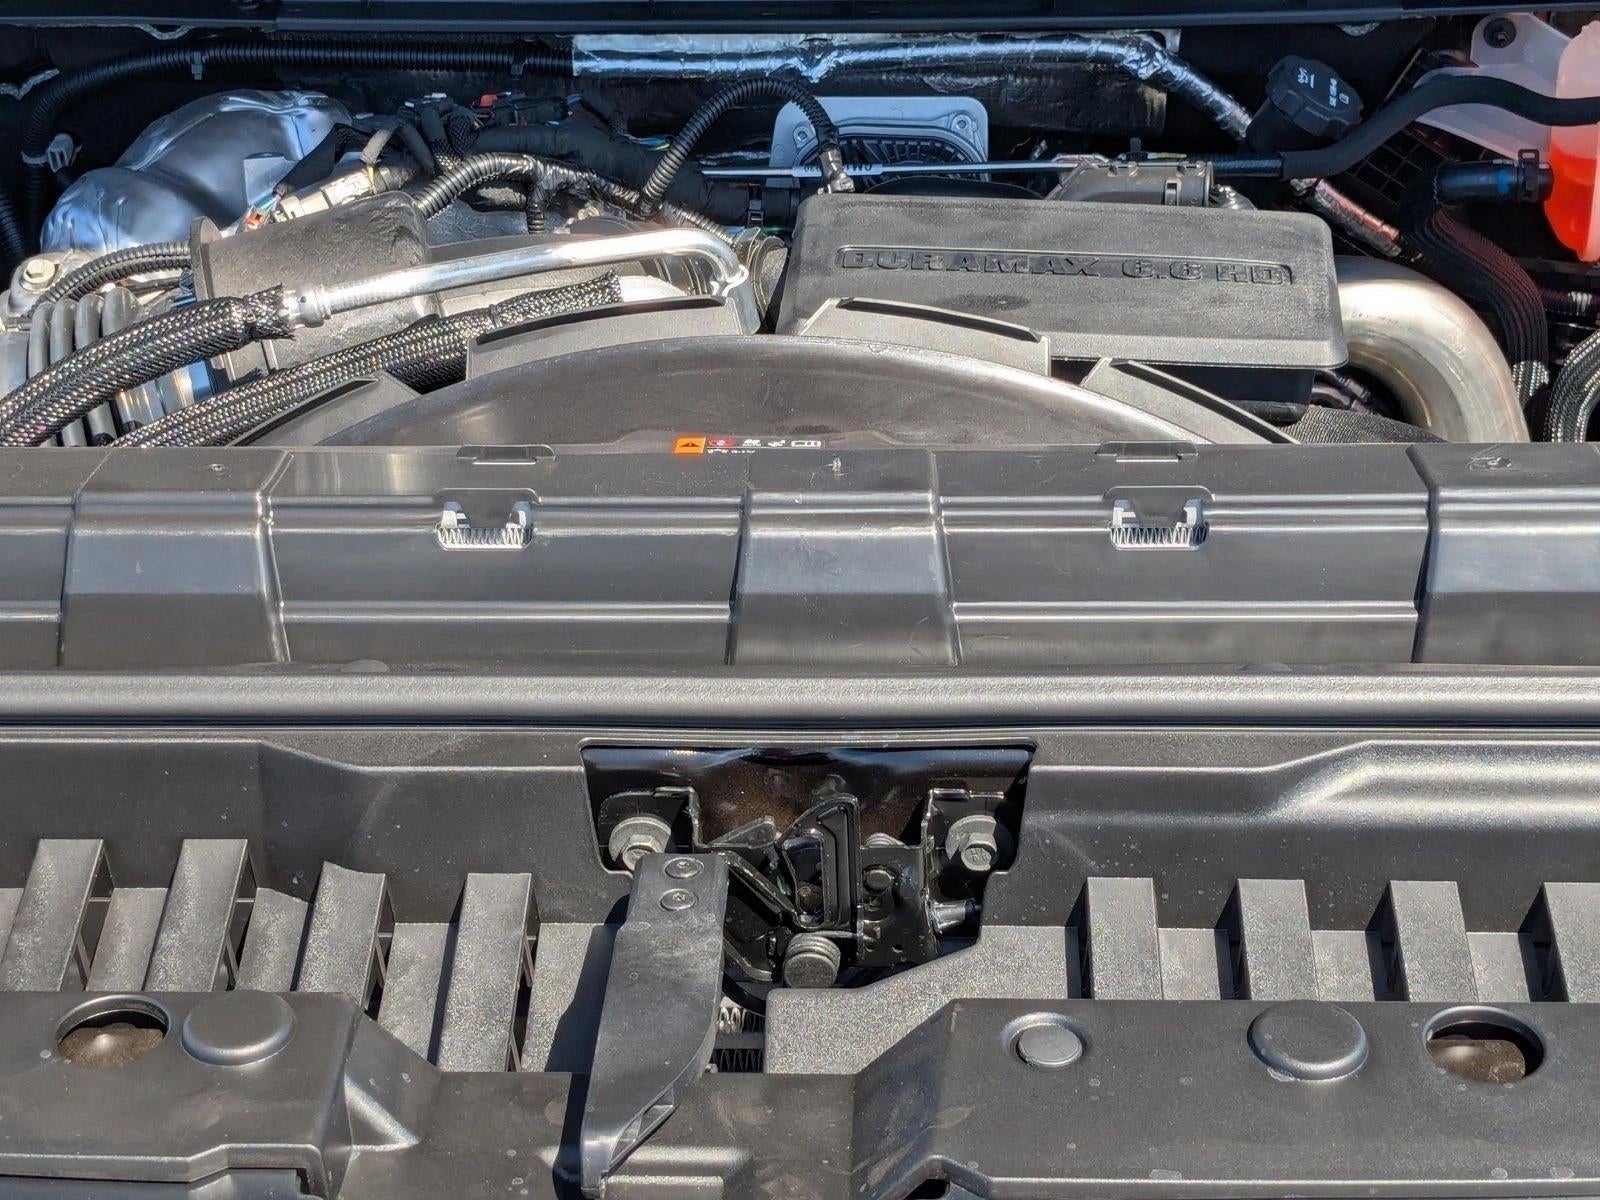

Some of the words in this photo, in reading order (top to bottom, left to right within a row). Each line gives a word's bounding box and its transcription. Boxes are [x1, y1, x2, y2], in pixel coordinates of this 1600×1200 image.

[842, 251, 1099, 277] DURAMAX
[1121, 258, 1202, 281] 6.6
[1216, 263, 1285, 285] HD
